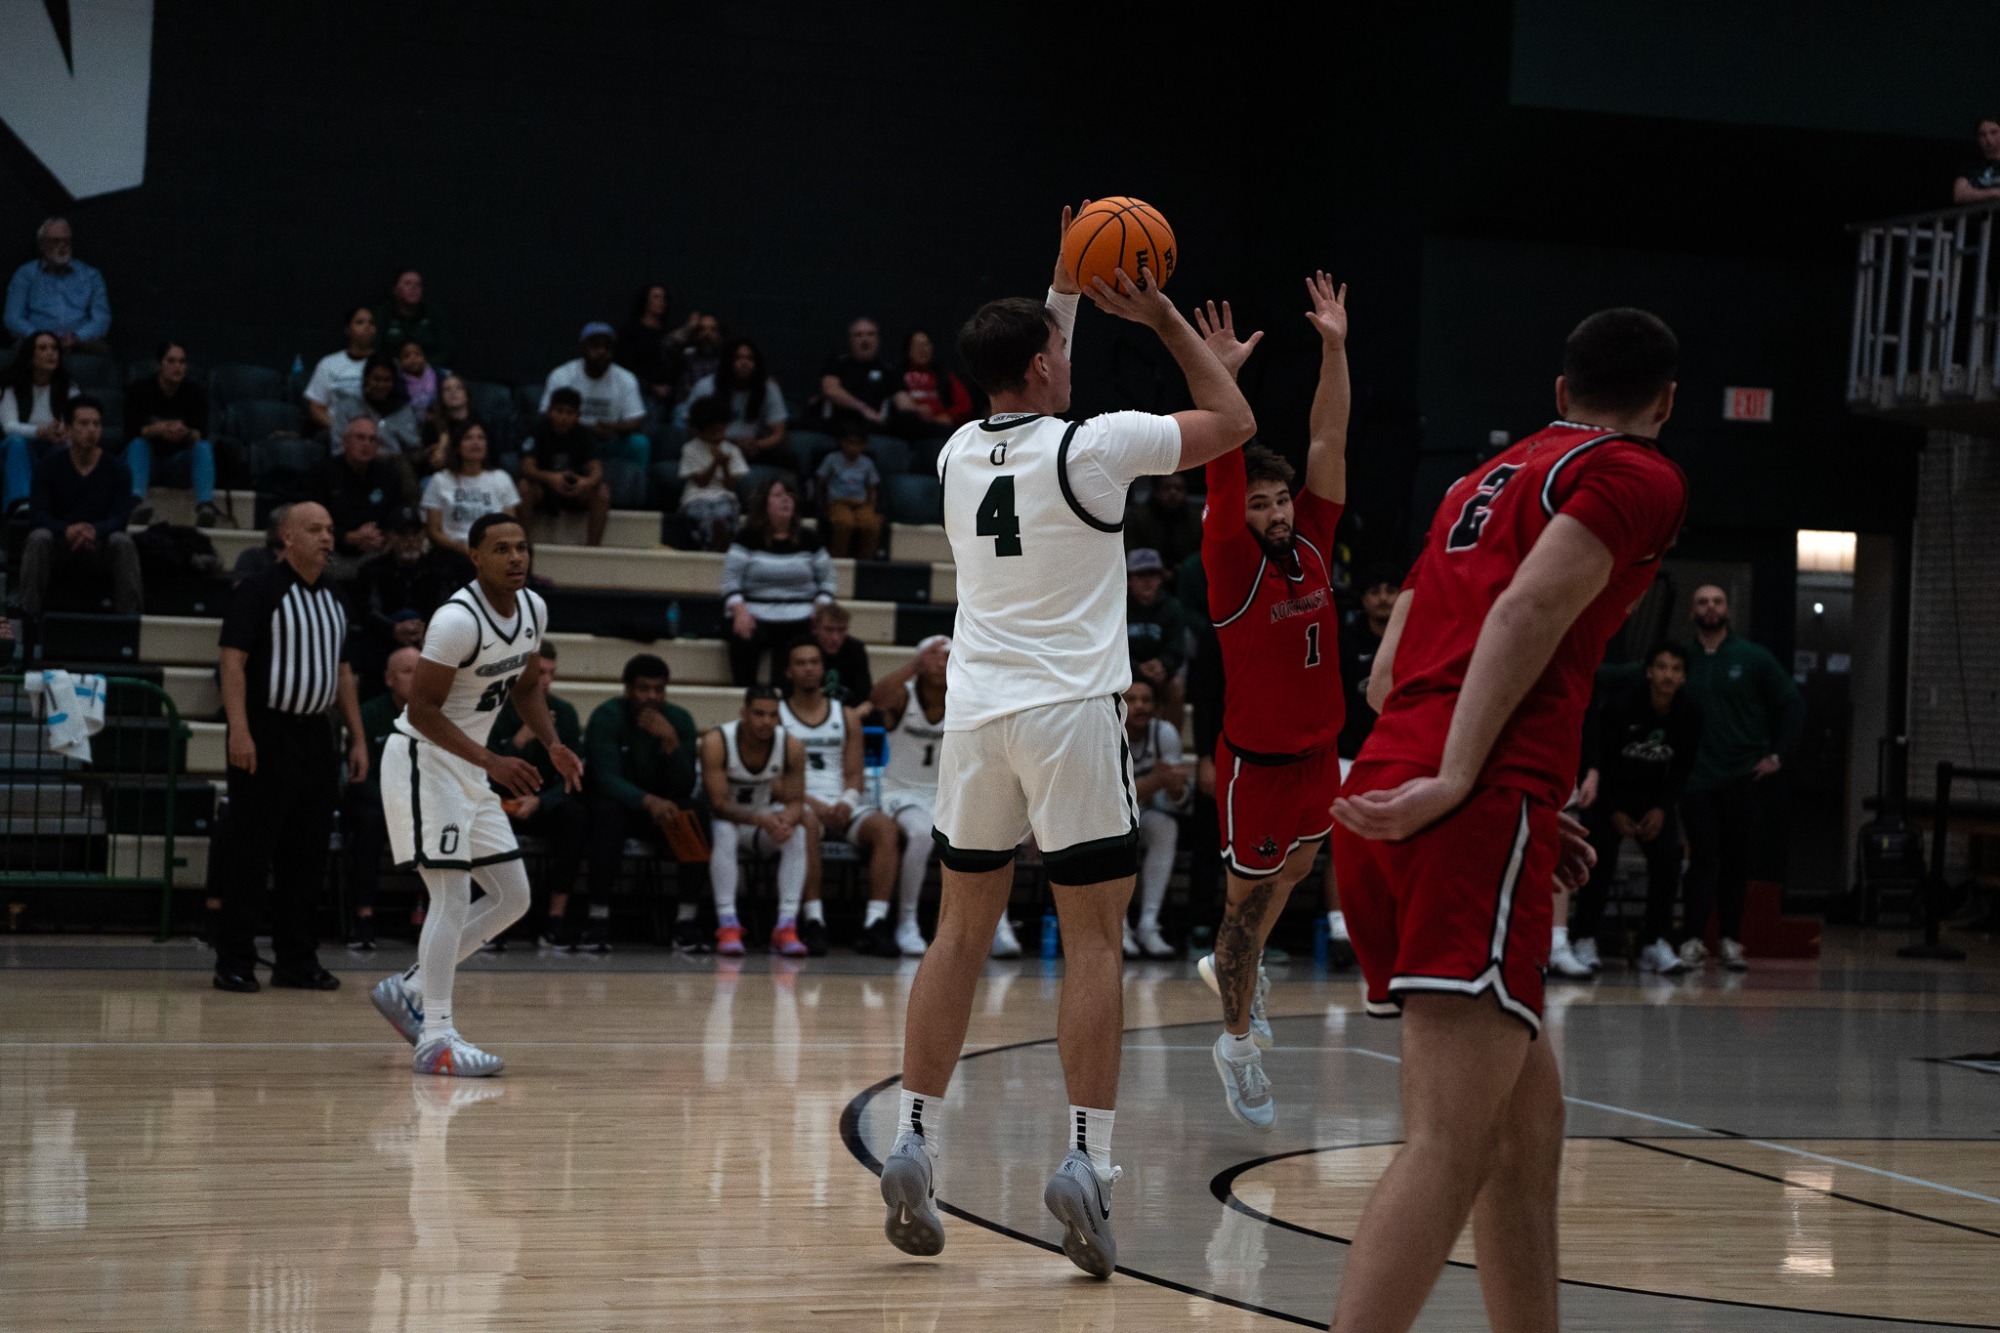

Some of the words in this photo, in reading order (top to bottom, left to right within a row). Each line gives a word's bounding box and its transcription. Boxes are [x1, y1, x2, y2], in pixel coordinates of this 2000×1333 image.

[1733, 388, 1766, 418] EXIT
[976, 475, 1023, 558] 4
[1444, 462, 1527, 554] 2
[1304, 621, 1321, 669] 1
